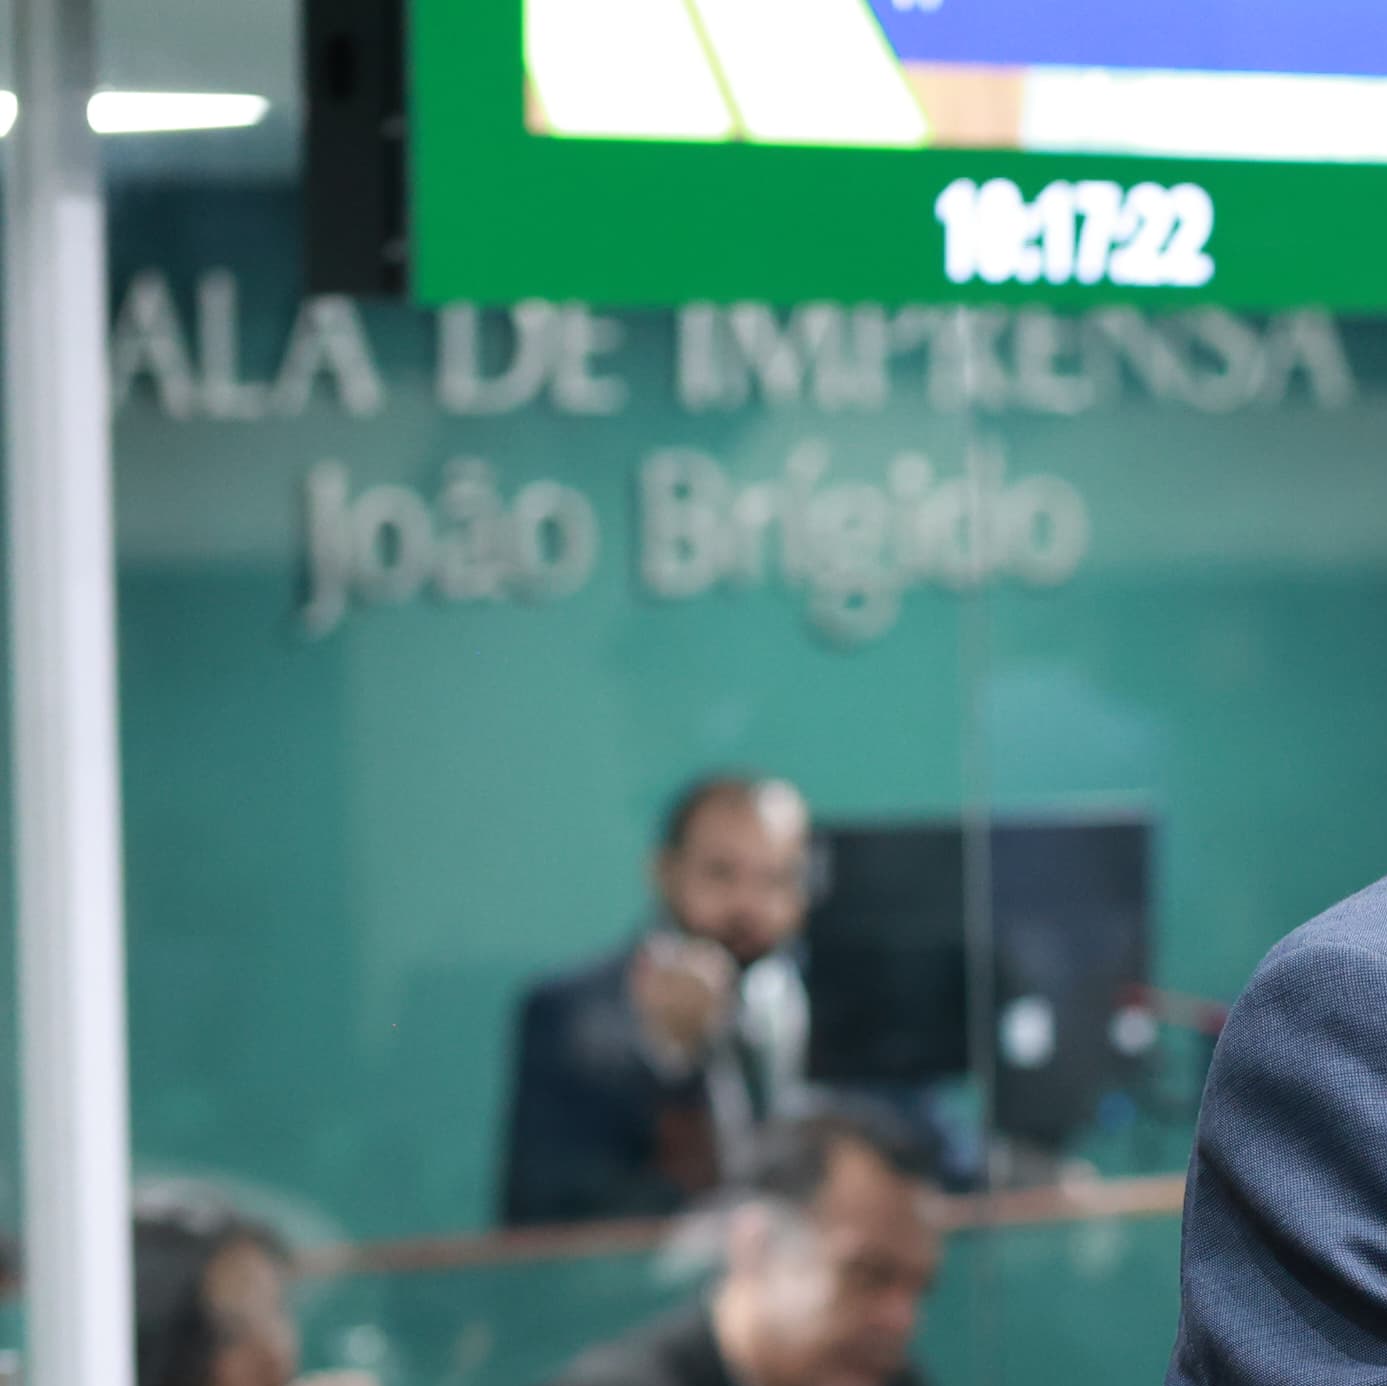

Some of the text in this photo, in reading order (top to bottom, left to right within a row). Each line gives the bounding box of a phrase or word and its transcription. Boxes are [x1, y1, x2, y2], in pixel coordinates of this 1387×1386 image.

[106, 268, 382, 418] ALA
[435, 298, 630, 414] DE
[304, 440, 1088, 640] João Brígido
